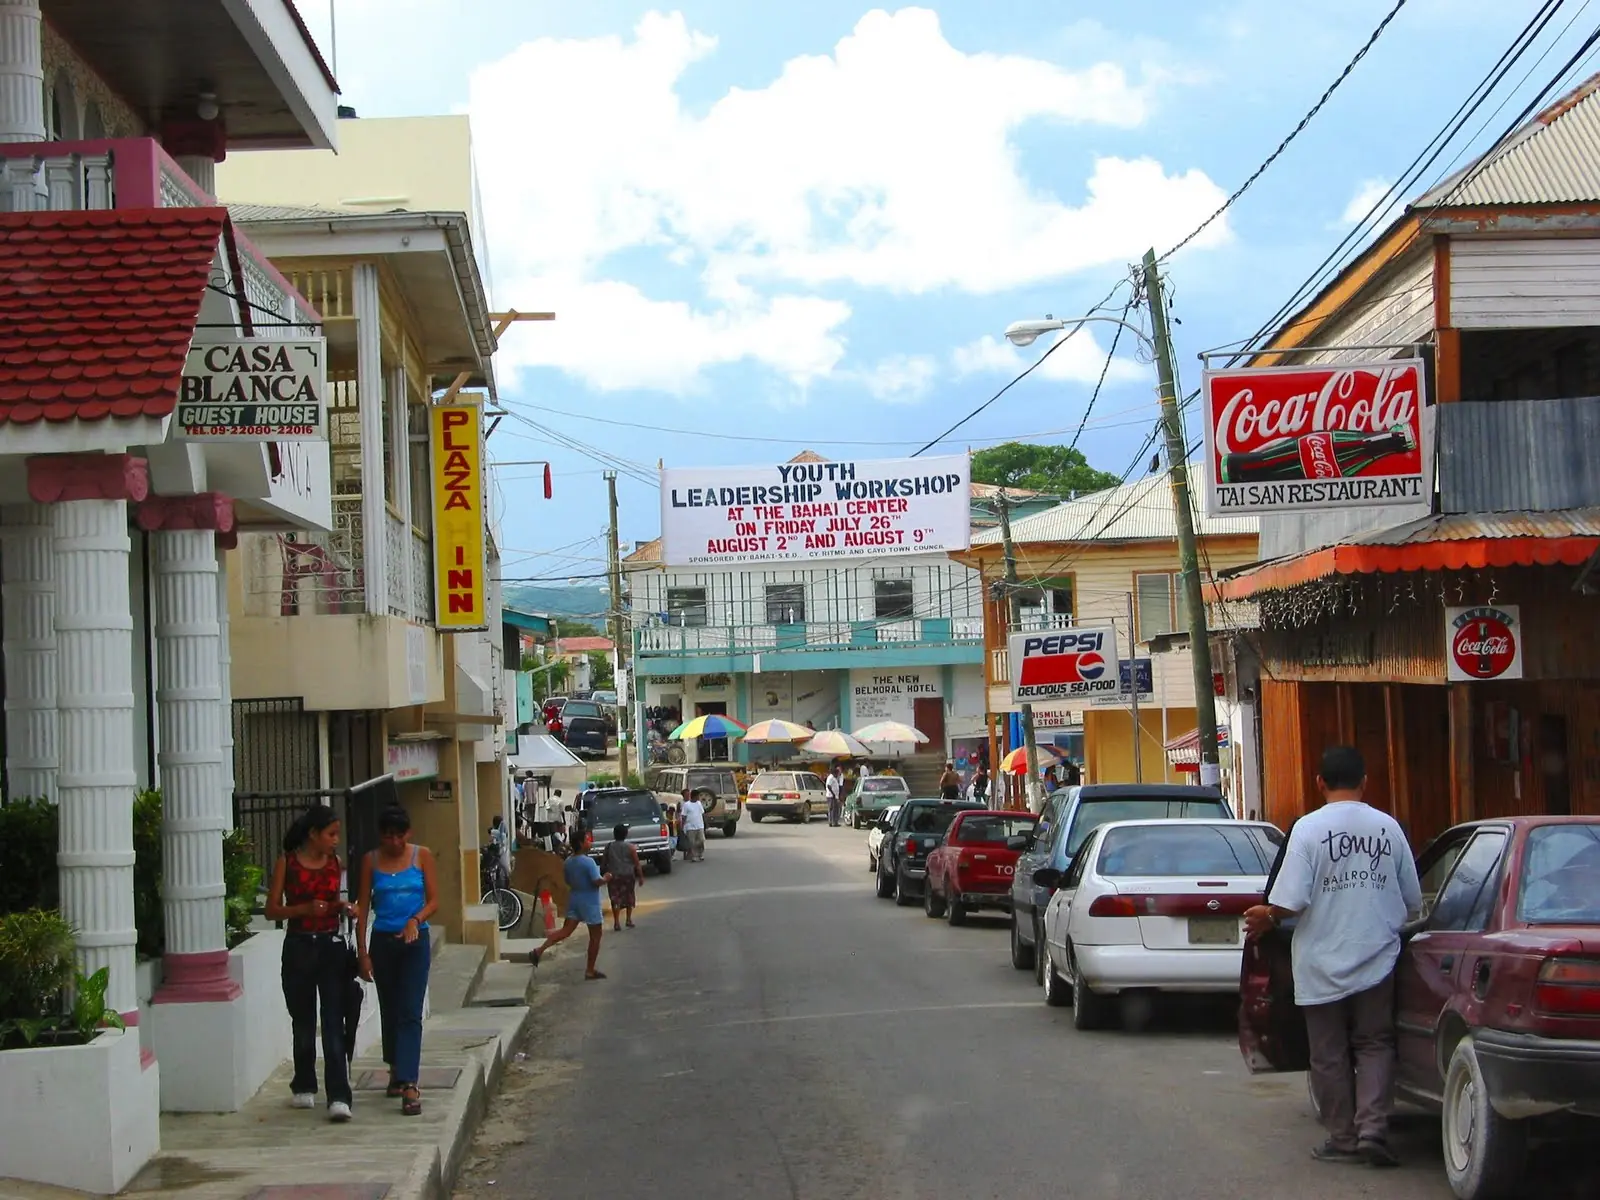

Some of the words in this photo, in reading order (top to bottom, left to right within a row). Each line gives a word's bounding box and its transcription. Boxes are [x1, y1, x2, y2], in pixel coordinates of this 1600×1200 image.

[204, 345, 294, 373] CASA
[180, 375, 319, 402] BLANCA
[182, 406, 245, 425] GUEST
[254, 406, 317, 424] HOUSE
[1216, 368, 1414, 453] Coca-Cola
[442, 411, 472, 510] PLAZA
[777, 462, 855, 484] YOUTH
[671, 484, 822, 508] LEADERSHIP
[835, 473, 961, 501] WORKSHOP
[1216, 487, 1245, 507] TAI
[1248, 484, 1285, 506] SAN
[1288, 476, 1424, 504] RESTAURANT
[727, 507, 745, 521] AT
[753, 505, 785, 520] THE
[846, 498, 909, 516] CENTER
[735, 521, 757, 537] ON
[764, 519, 816, 536] FRIDAY
[826, 516, 861, 532] JULY
[707, 537, 769, 554] AUGUST
[805, 533, 836, 550] AND
[844, 530, 905, 548] AUGUST
[688, 555, 735, 563] SPONSORED
[447, 546, 474, 613] INN
[1024, 632, 1104, 657] PEPSI
[1457, 636, 1509, 656] Coca-Cola
[855, 685, 902, 695] BELMORAL
[907, 684, 937, 693] HOTEL
[872, 675, 893, 685] THE
[898, 674, 920, 684] NEW
[1017, 683, 1067, 697] DELICIOUS
[1070, 680, 1116, 692] SEAFOOD
[1037, 718, 1065, 726] STORE
[1321, 828, 1392, 871] tony's
[994, 865, 1017, 875] TO
[1323, 870, 1388, 886] BALLROOM
